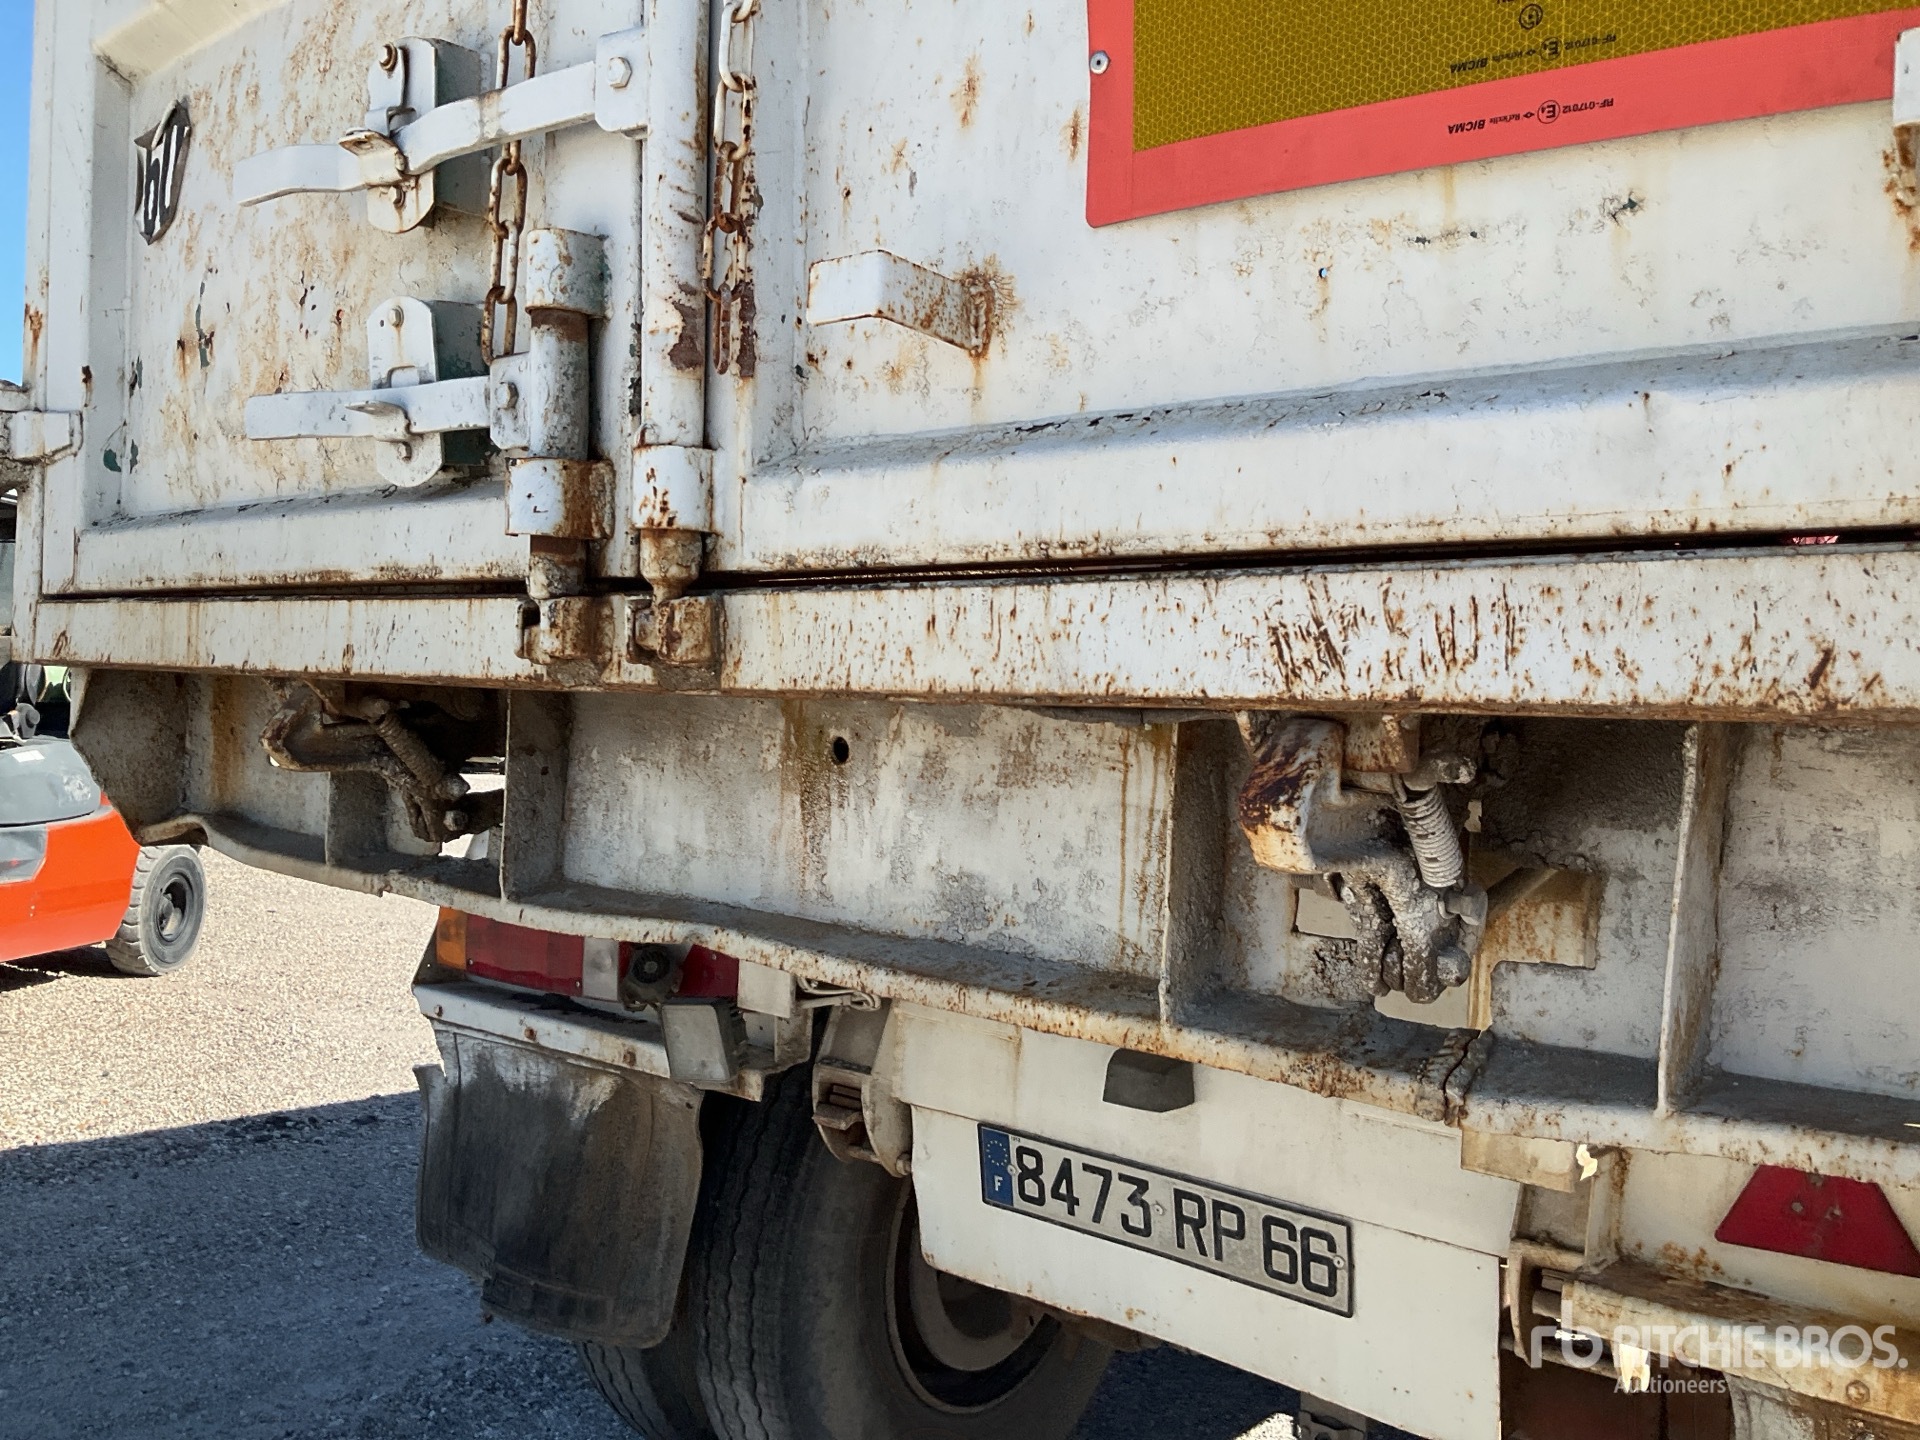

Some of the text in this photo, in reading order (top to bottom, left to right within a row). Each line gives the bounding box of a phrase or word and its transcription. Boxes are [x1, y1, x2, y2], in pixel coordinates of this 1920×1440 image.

[1450, 57, 1488, 74] BICMA
[1562, 98, 1614, 114] RF-017012
[1448, 119, 1485, 135] BICMA
[994, 1175, 1003, 1192] F
[1015, 1145, 1337, 1298] 8473 RP 66
